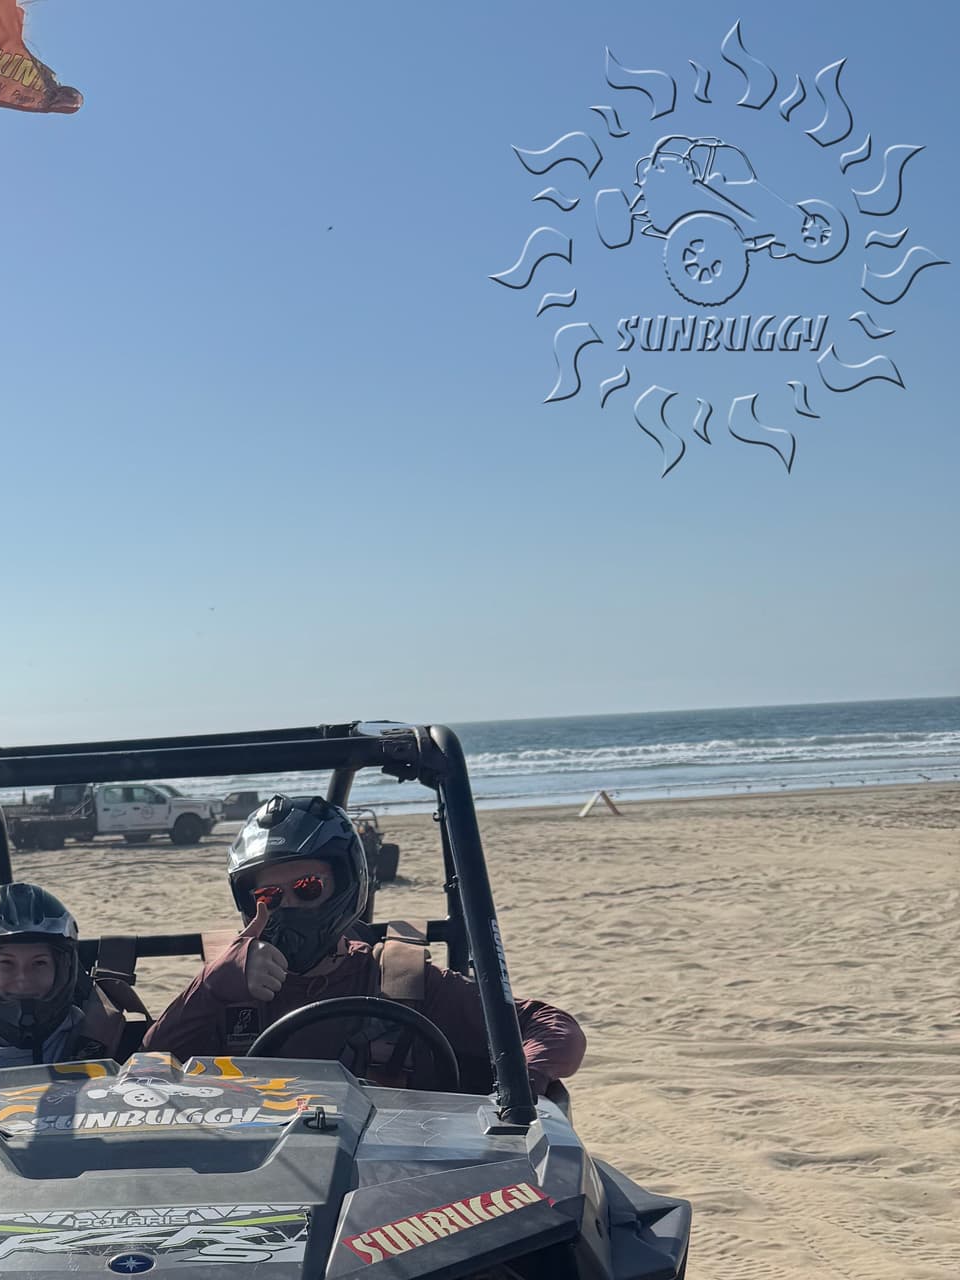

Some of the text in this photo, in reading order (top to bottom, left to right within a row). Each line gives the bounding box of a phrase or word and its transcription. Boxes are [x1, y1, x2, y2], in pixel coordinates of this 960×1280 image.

[31, 1106, 262, 1132] SUNBUGGY
[74, 1215, 190, 1229] POLARIS
[351, 1182, 543, 1265] SUNBUGGY
